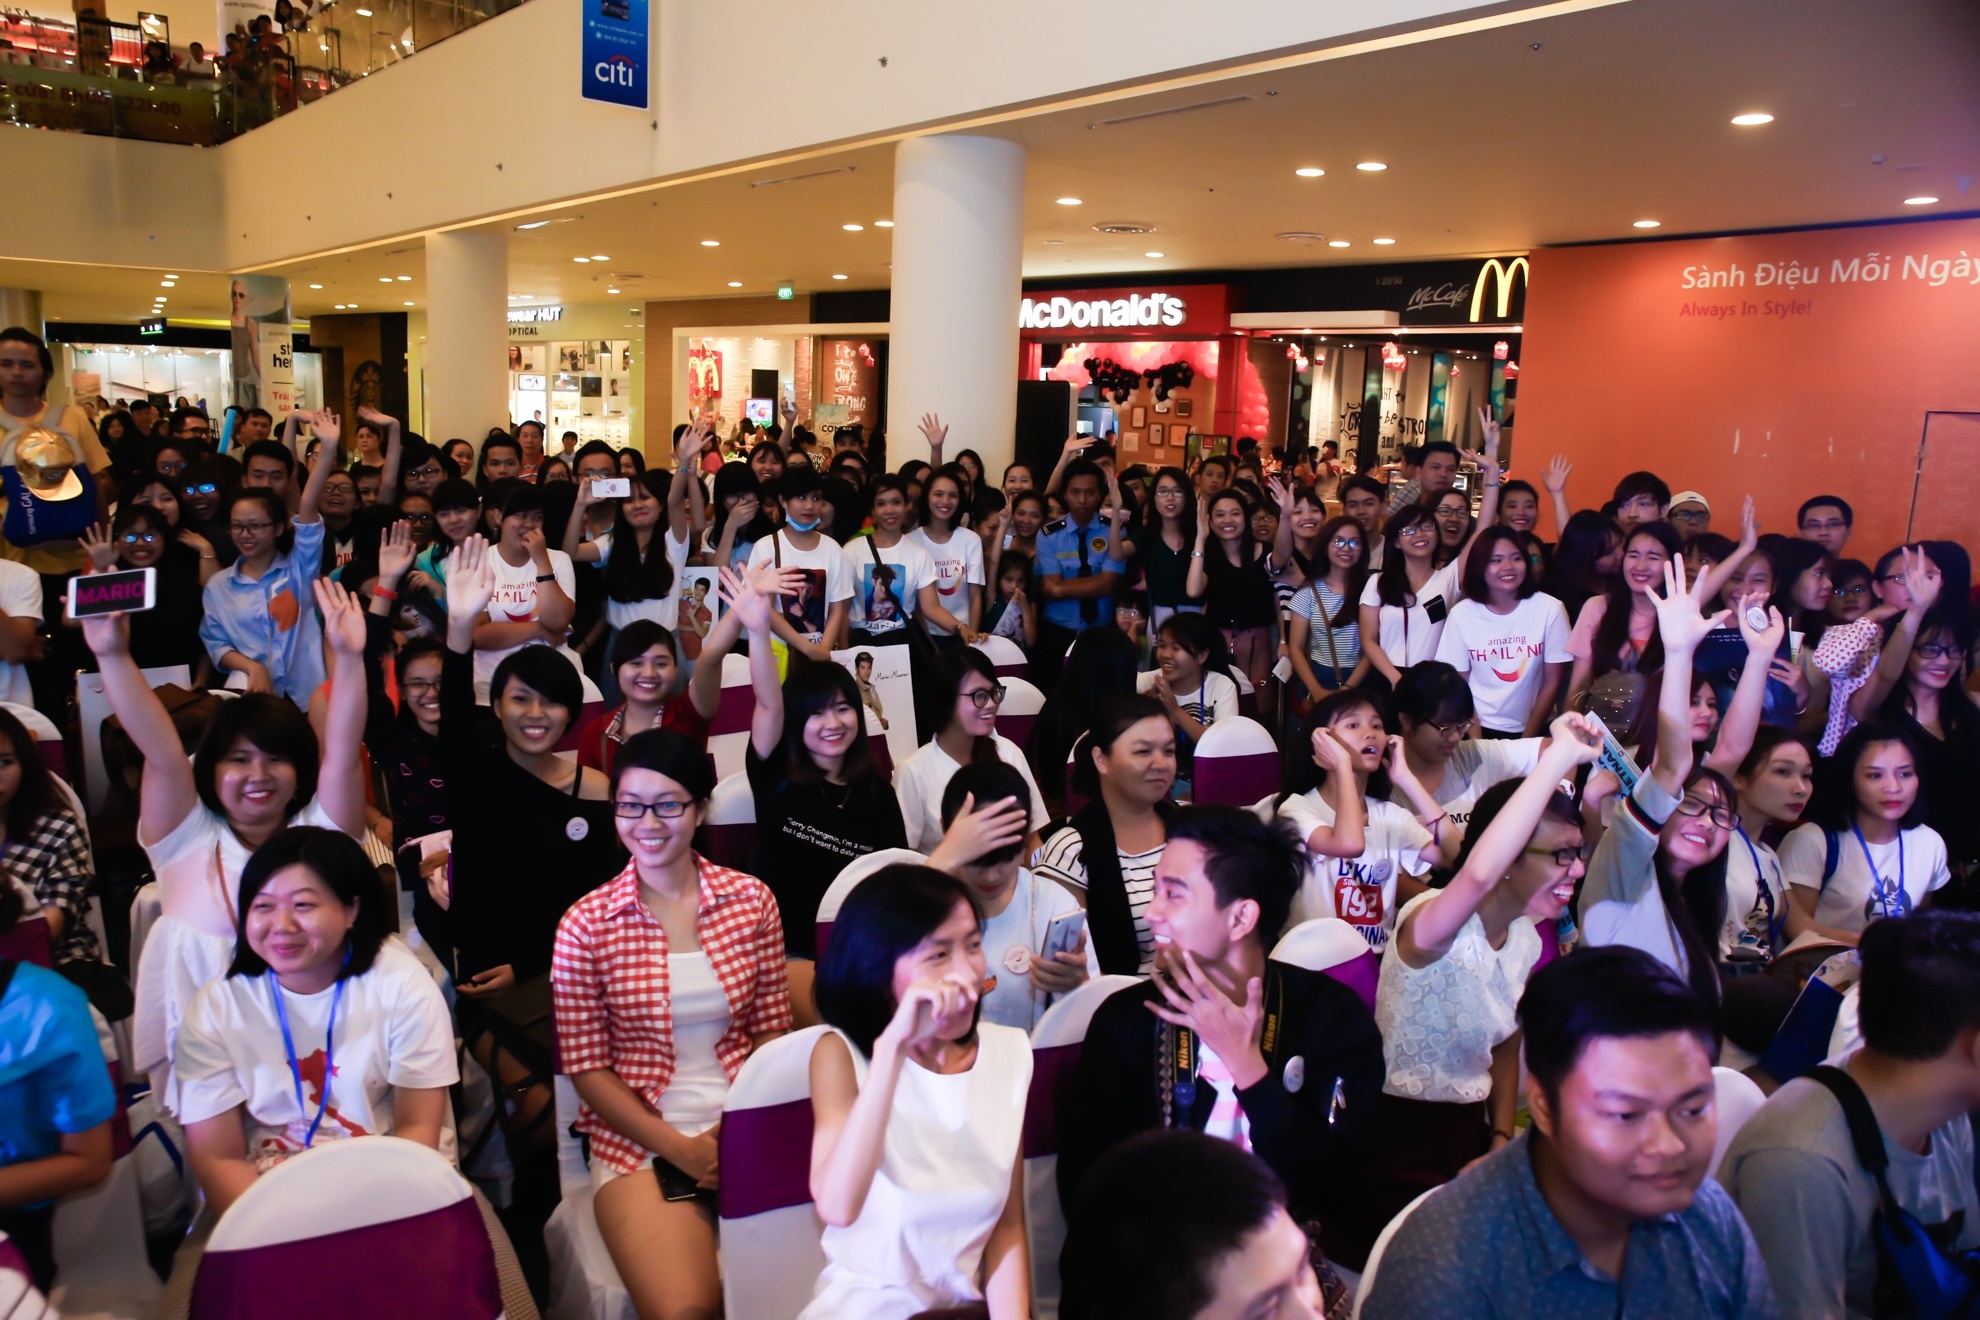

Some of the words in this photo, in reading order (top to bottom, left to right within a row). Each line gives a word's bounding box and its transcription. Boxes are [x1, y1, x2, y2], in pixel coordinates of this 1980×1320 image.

[595, 61, 633, 87] citi
[1681, 264, 1745, 289] Sành
[1754, 260, 1820, 290] Điệu
[1830, 252, 1891, 284] Mỗi
[1407, 282, 1470, 309] McCafé
[538, 307, 562, 321] HUT
[1680, 302, 1737, 320] Always
[1741, 301, 1757, 316] In
[1764, 299, 1812, 319] Style!
[77, 581, 146, 604] MARIO
[1488, 635, 1526, 646] amazing
[815, 839, 832, 850] want
[832, 845, 839, 853] to
[1262, 1013, 1277, 1053] Nikon
[1178, 1031, 1189, 1069] Nikon
